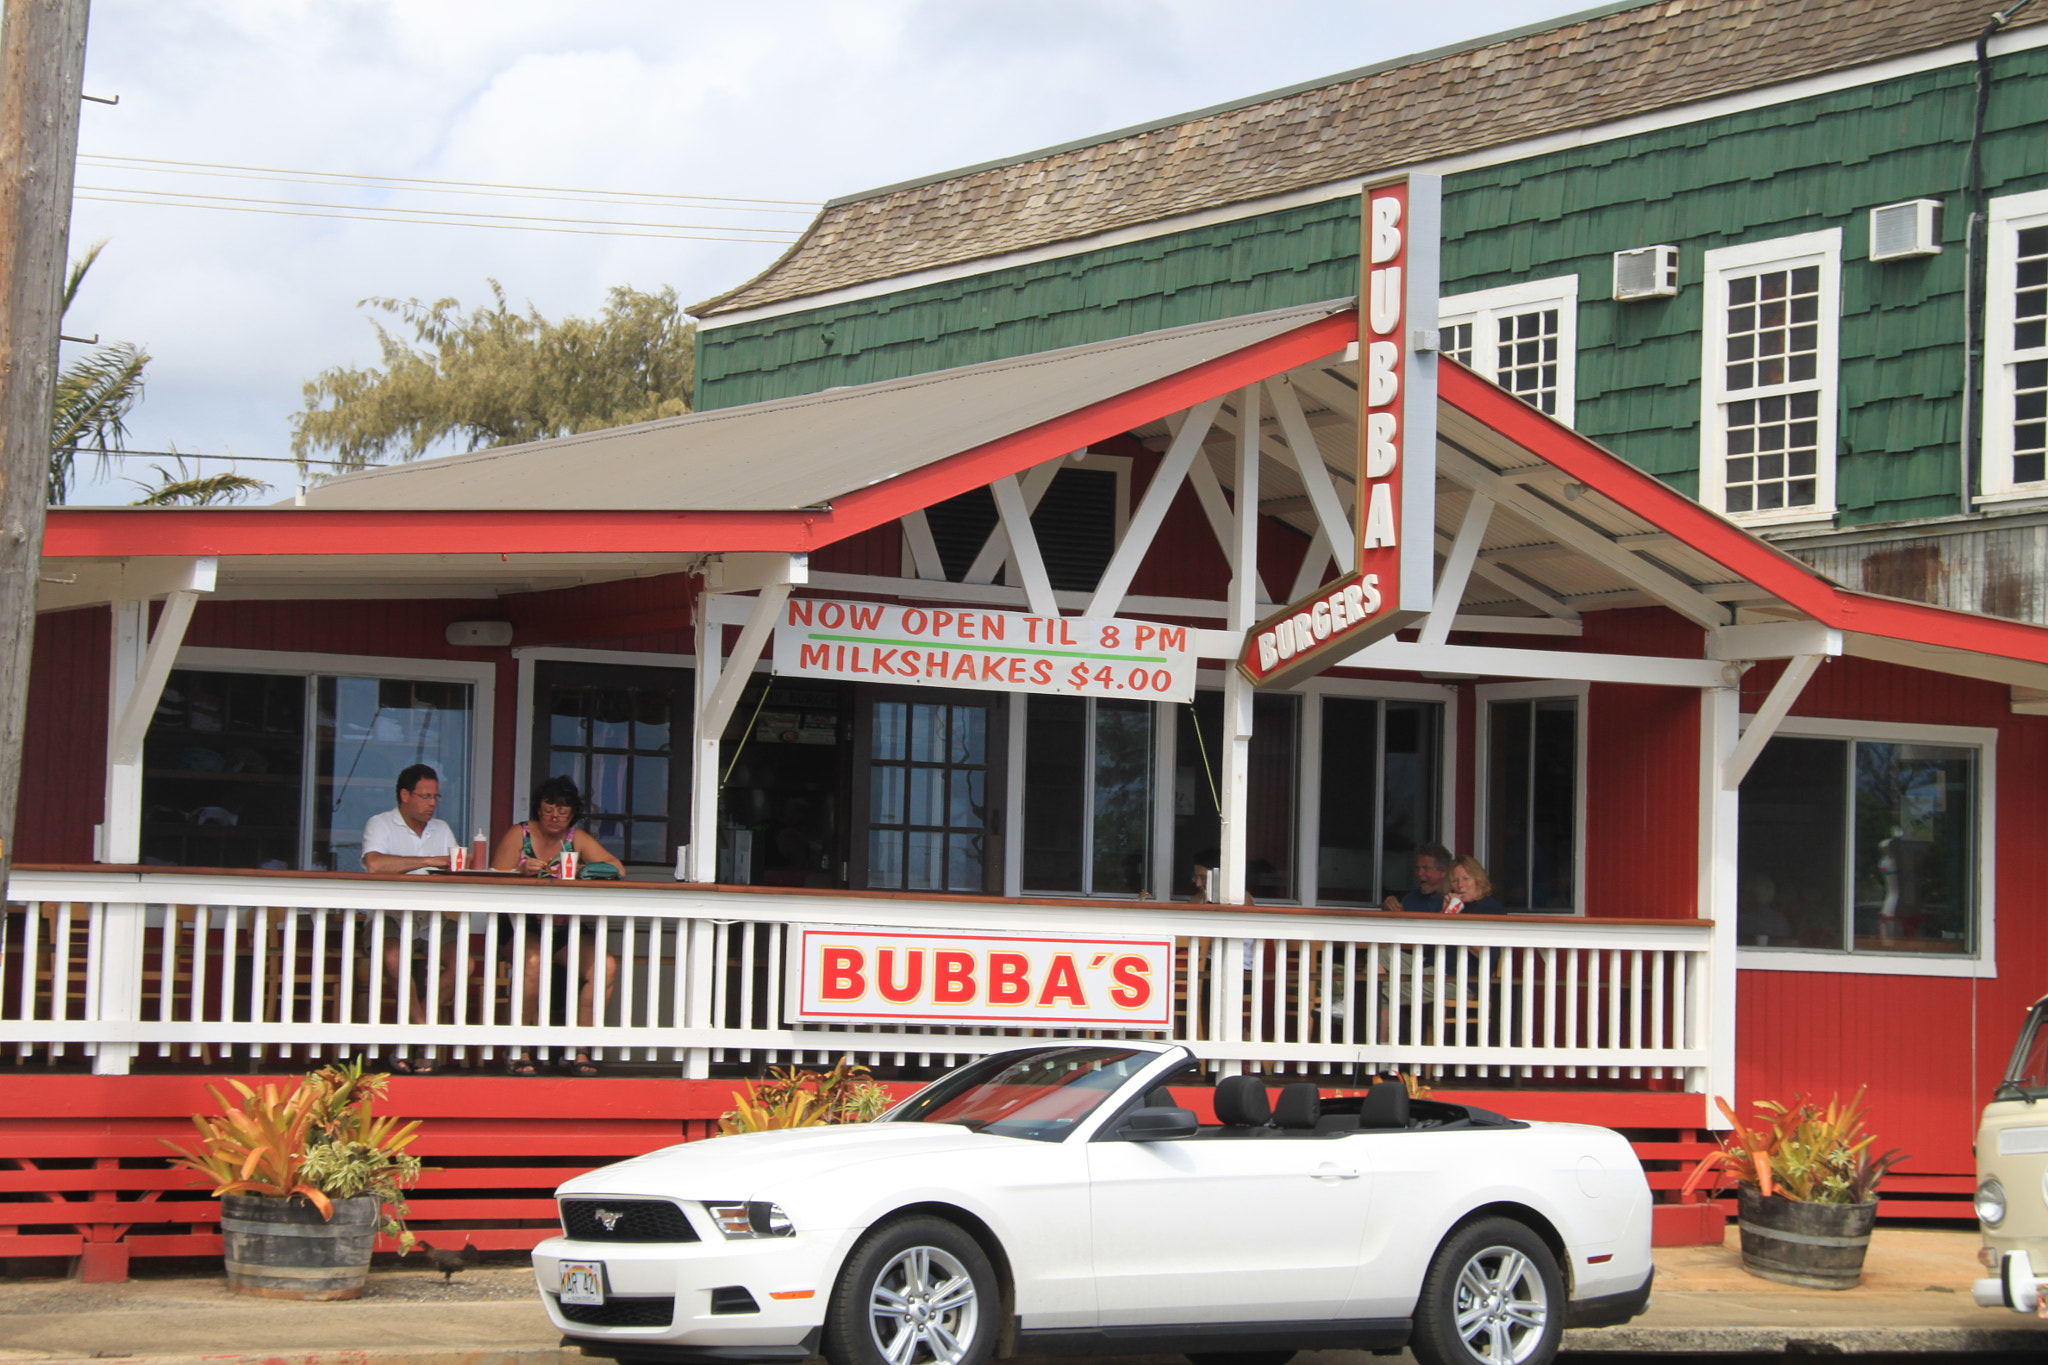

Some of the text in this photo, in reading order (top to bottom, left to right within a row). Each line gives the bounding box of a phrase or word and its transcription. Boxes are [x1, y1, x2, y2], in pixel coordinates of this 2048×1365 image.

[1364, 196, 1402, 549] BUBBA
[788, 600, 1186, 652] NOW OPEN TIL 8 PM
[1257, 573, 1382, 672] BURGERS
[800, 644, 1172, 691] MILKSHAKES $4.00
[819, 944, 1153, 1011] BUBBA'S
